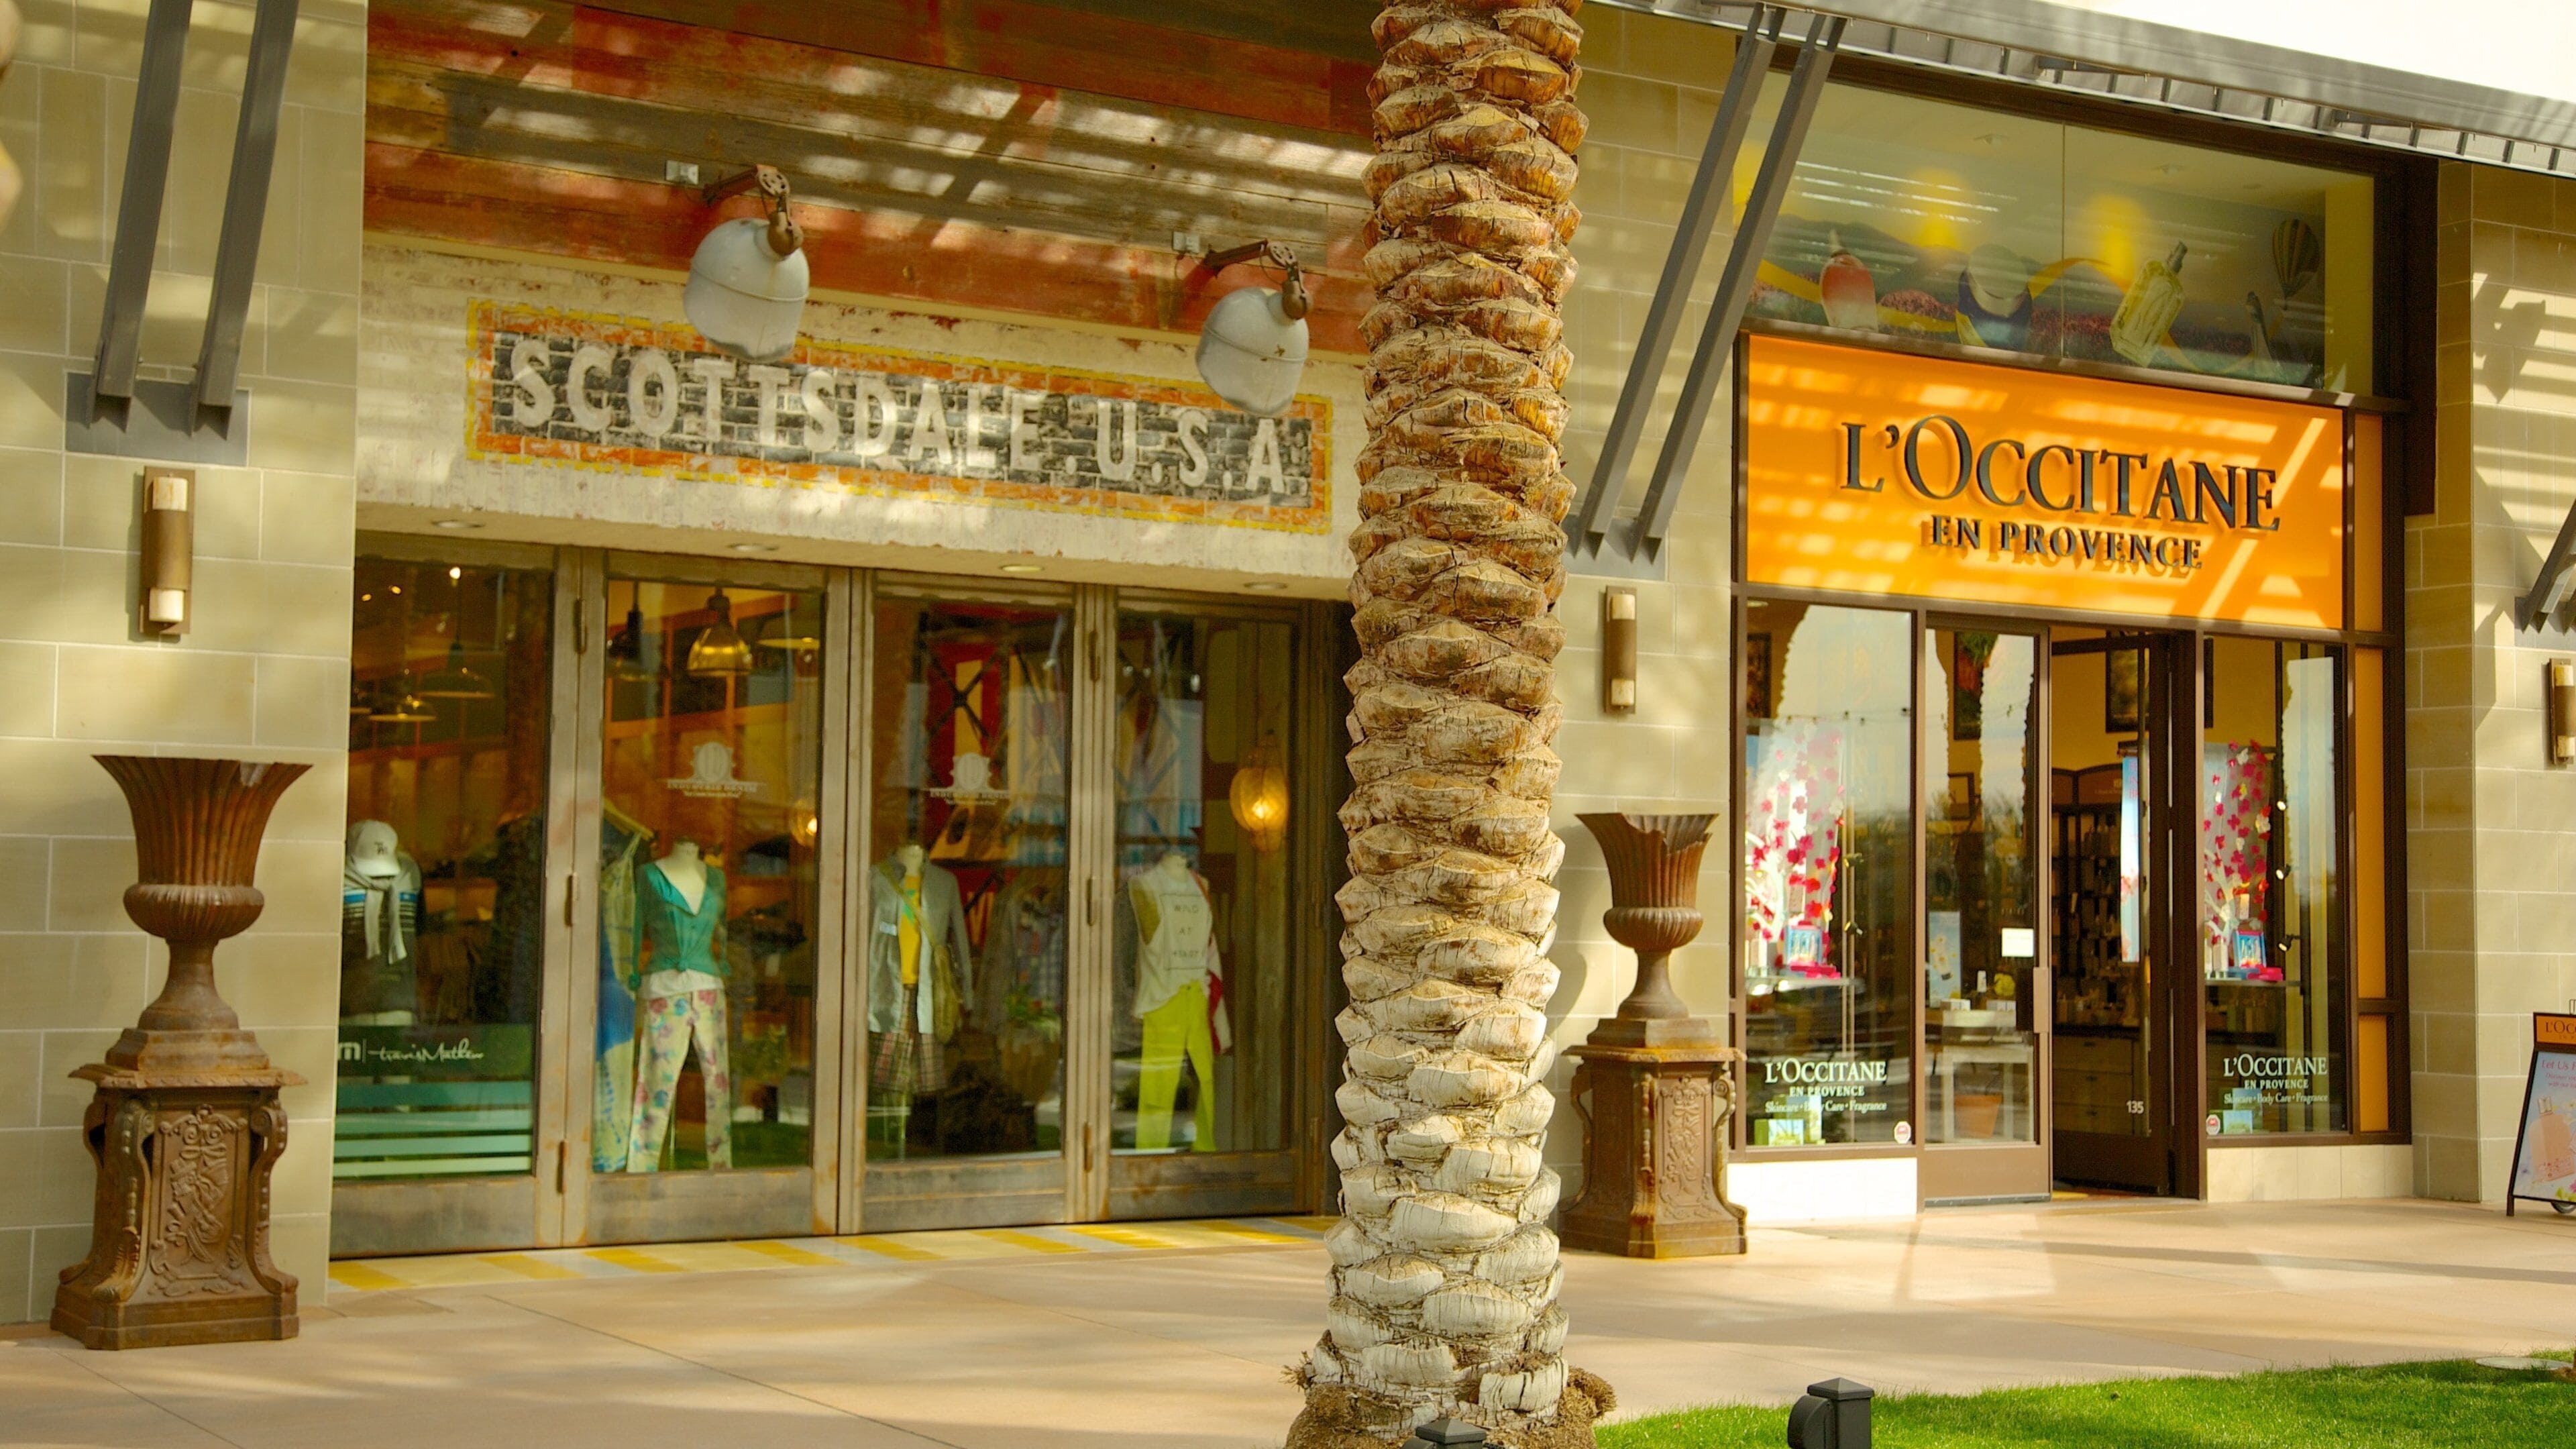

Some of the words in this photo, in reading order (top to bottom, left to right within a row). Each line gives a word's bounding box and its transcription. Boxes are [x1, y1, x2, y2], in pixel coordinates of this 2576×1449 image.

[1841, 415, 2280, 531] L'OCCITANE
[1932, 515, 1981, 549] EN
[2000, 525, 2203, 569] PROVENCE
[1765, 1058, 1887, 1083] L'OCCITANE
[2223, 1054, 2328, 1077] L'OCCITANE
[2558, 1061, 2569, 1071] Us
[1789, 1086, 1804, 1097] EN
[1807, 1085, 1865, 1097] PROVENCE
[2245, 1080, 2257, 1089] EN
[2260, 1079, 2308, 1089] PROVENCE
[2127, 1100, 2144, 1114] 135
